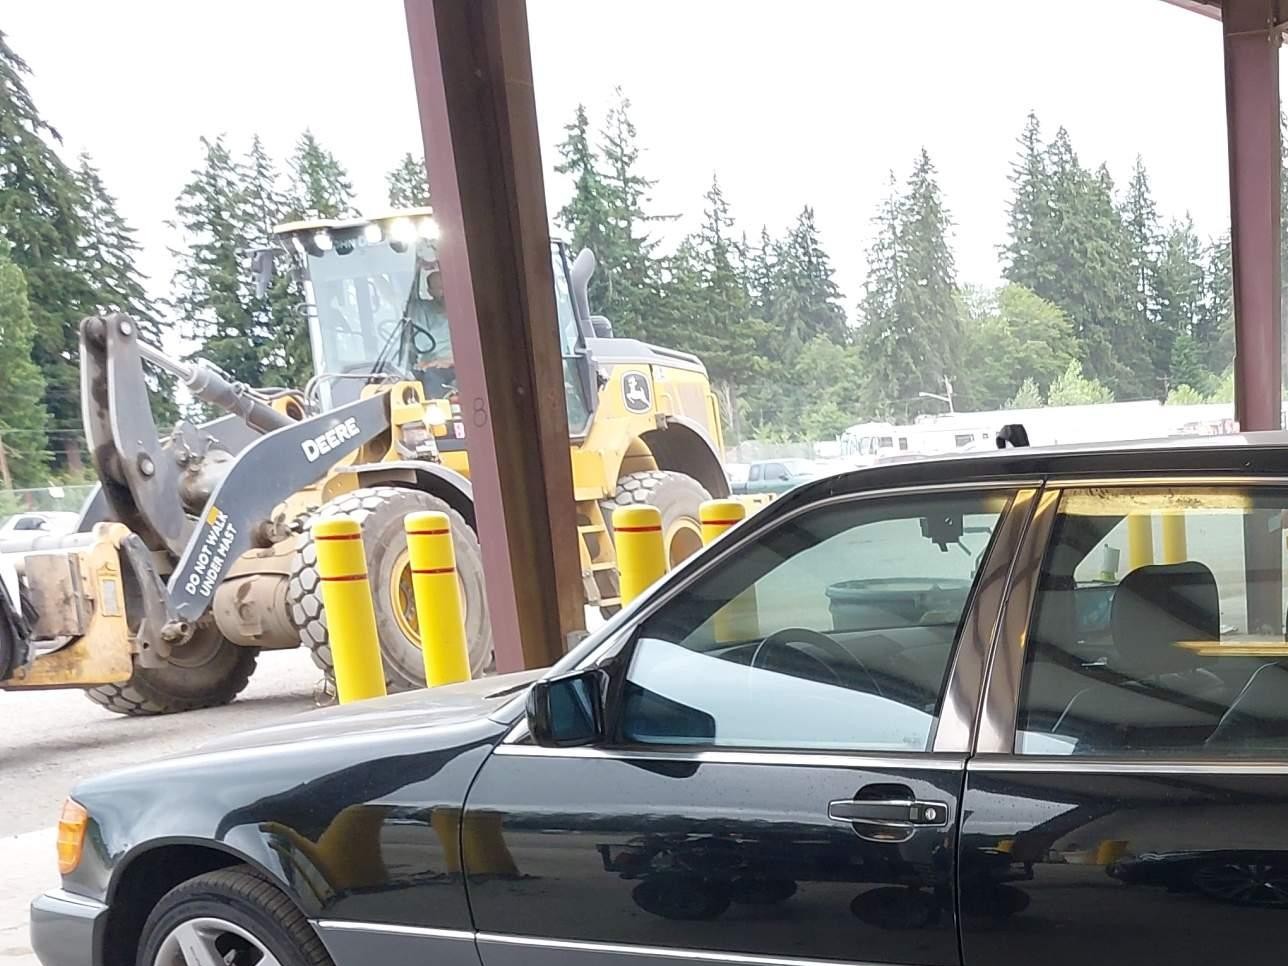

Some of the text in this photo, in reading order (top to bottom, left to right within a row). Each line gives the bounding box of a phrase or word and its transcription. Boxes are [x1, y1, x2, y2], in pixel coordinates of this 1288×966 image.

[301, 417, 360, 462] DEERE
[185, 510, 229, 595] DO NOT WALK
[200, 522, 237, 597] UNDER MAST
